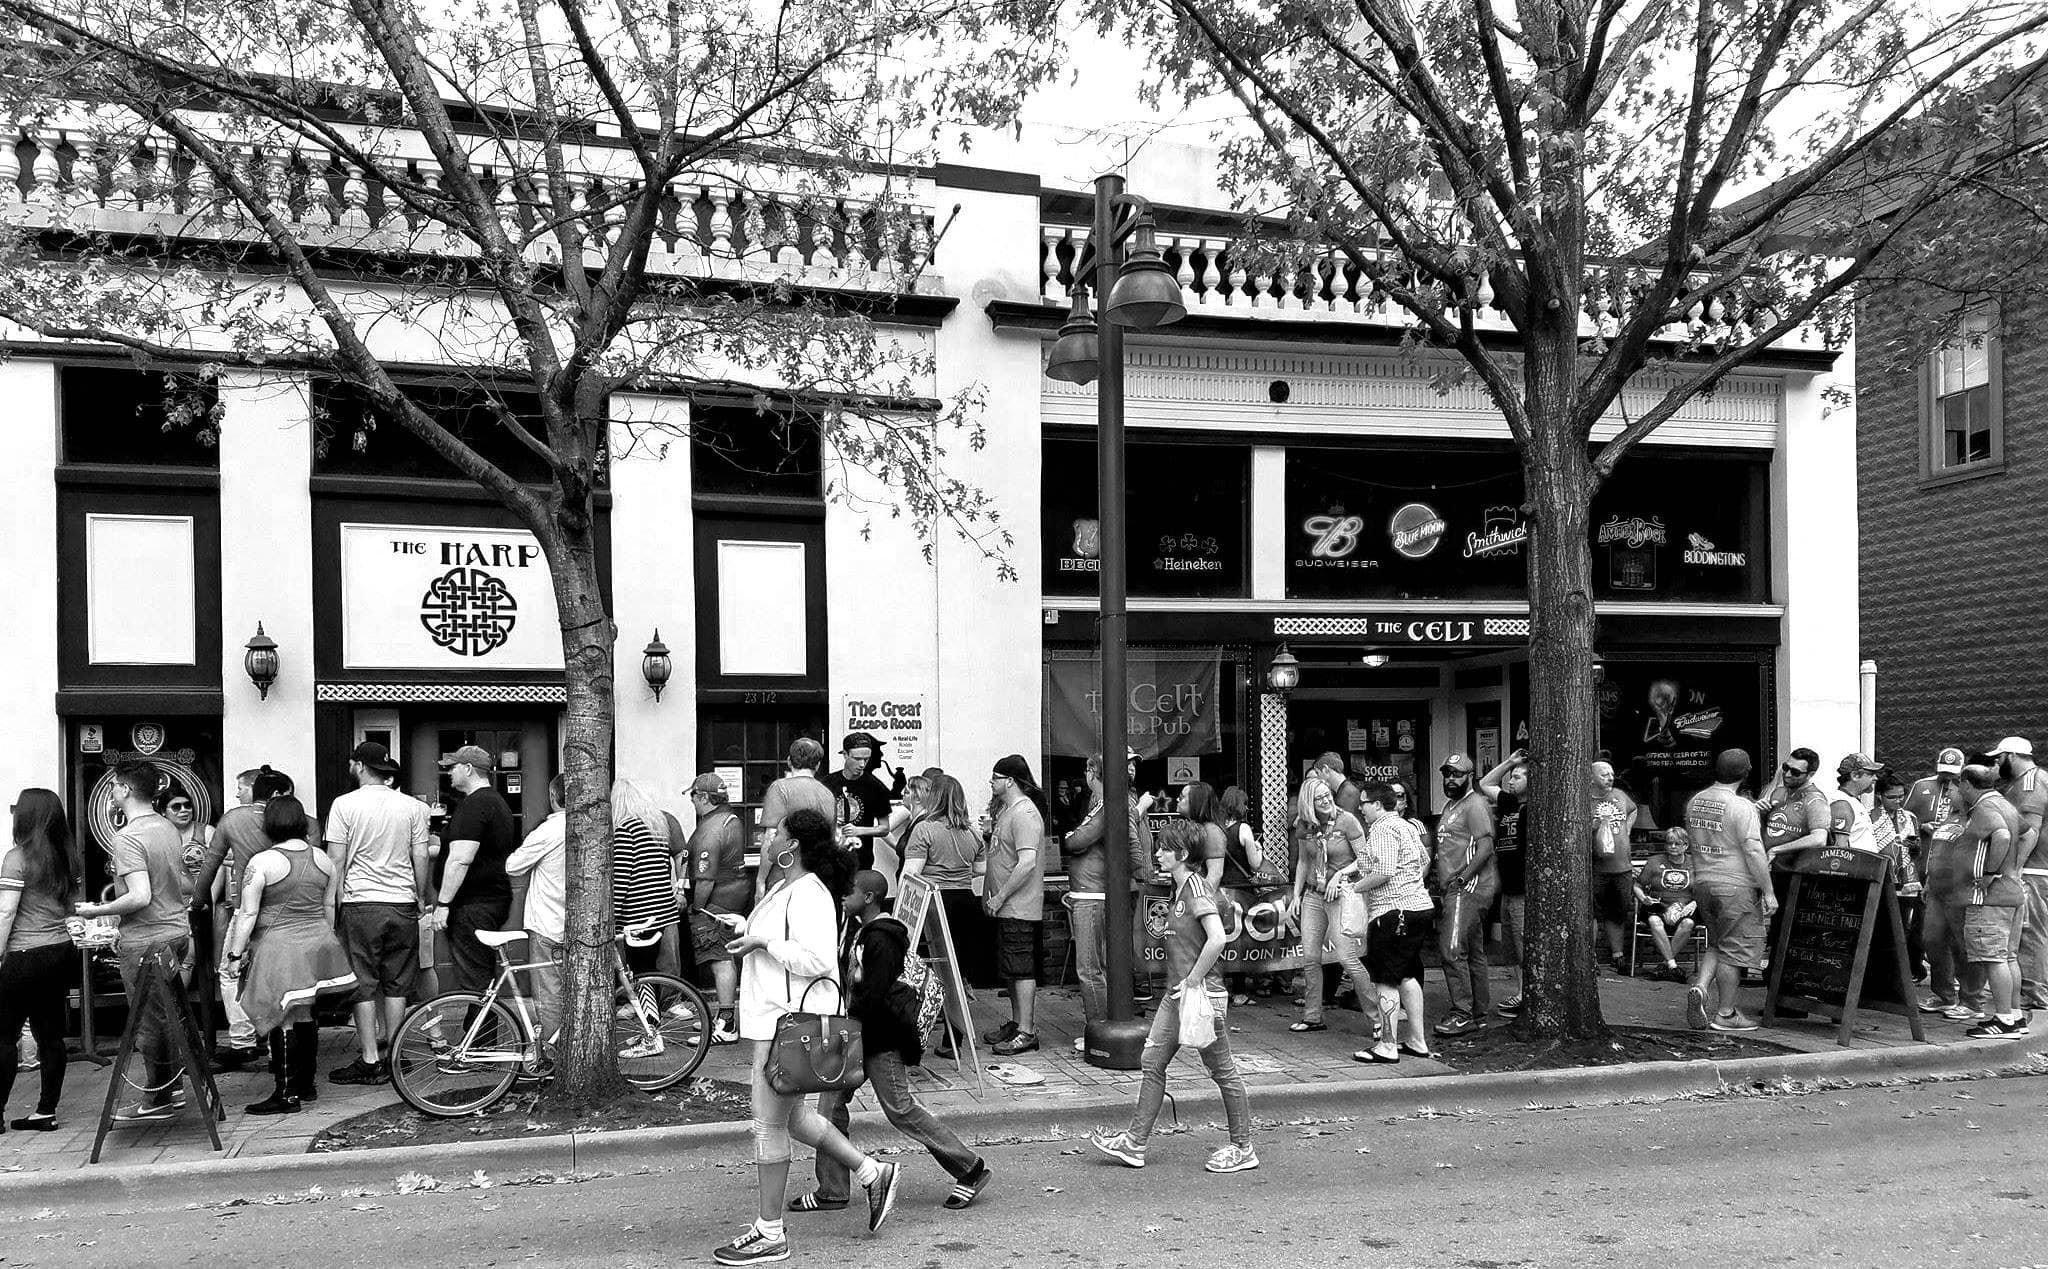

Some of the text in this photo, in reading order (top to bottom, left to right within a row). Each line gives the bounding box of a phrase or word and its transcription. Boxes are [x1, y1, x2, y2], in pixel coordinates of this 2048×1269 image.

[390, 541, 540, 567] THE HARP
[1684, 550, 1745, 566] BODDINGTONS
[1060, 559, 1100, 571] BEC
[1164, 558, 1222, 570] Heineken
[1296, 559, 1379, 568] BUDWEISER
[1375, 621, 1474, 641] THE CELT
[848, 700, 921, 717] The Great
[848, 717, 922, 730] Escape Room
[1151, 716, 1191, 735] Pub
[1364, 766, 1399, 777] SOCCER
[1820, 849, 1855, 862] JAMESON
[1145, 948, 1168, 960] SIG
[1243, 948, 1275, 961] JOIN
[1280, 945, 1304, 957] THE
